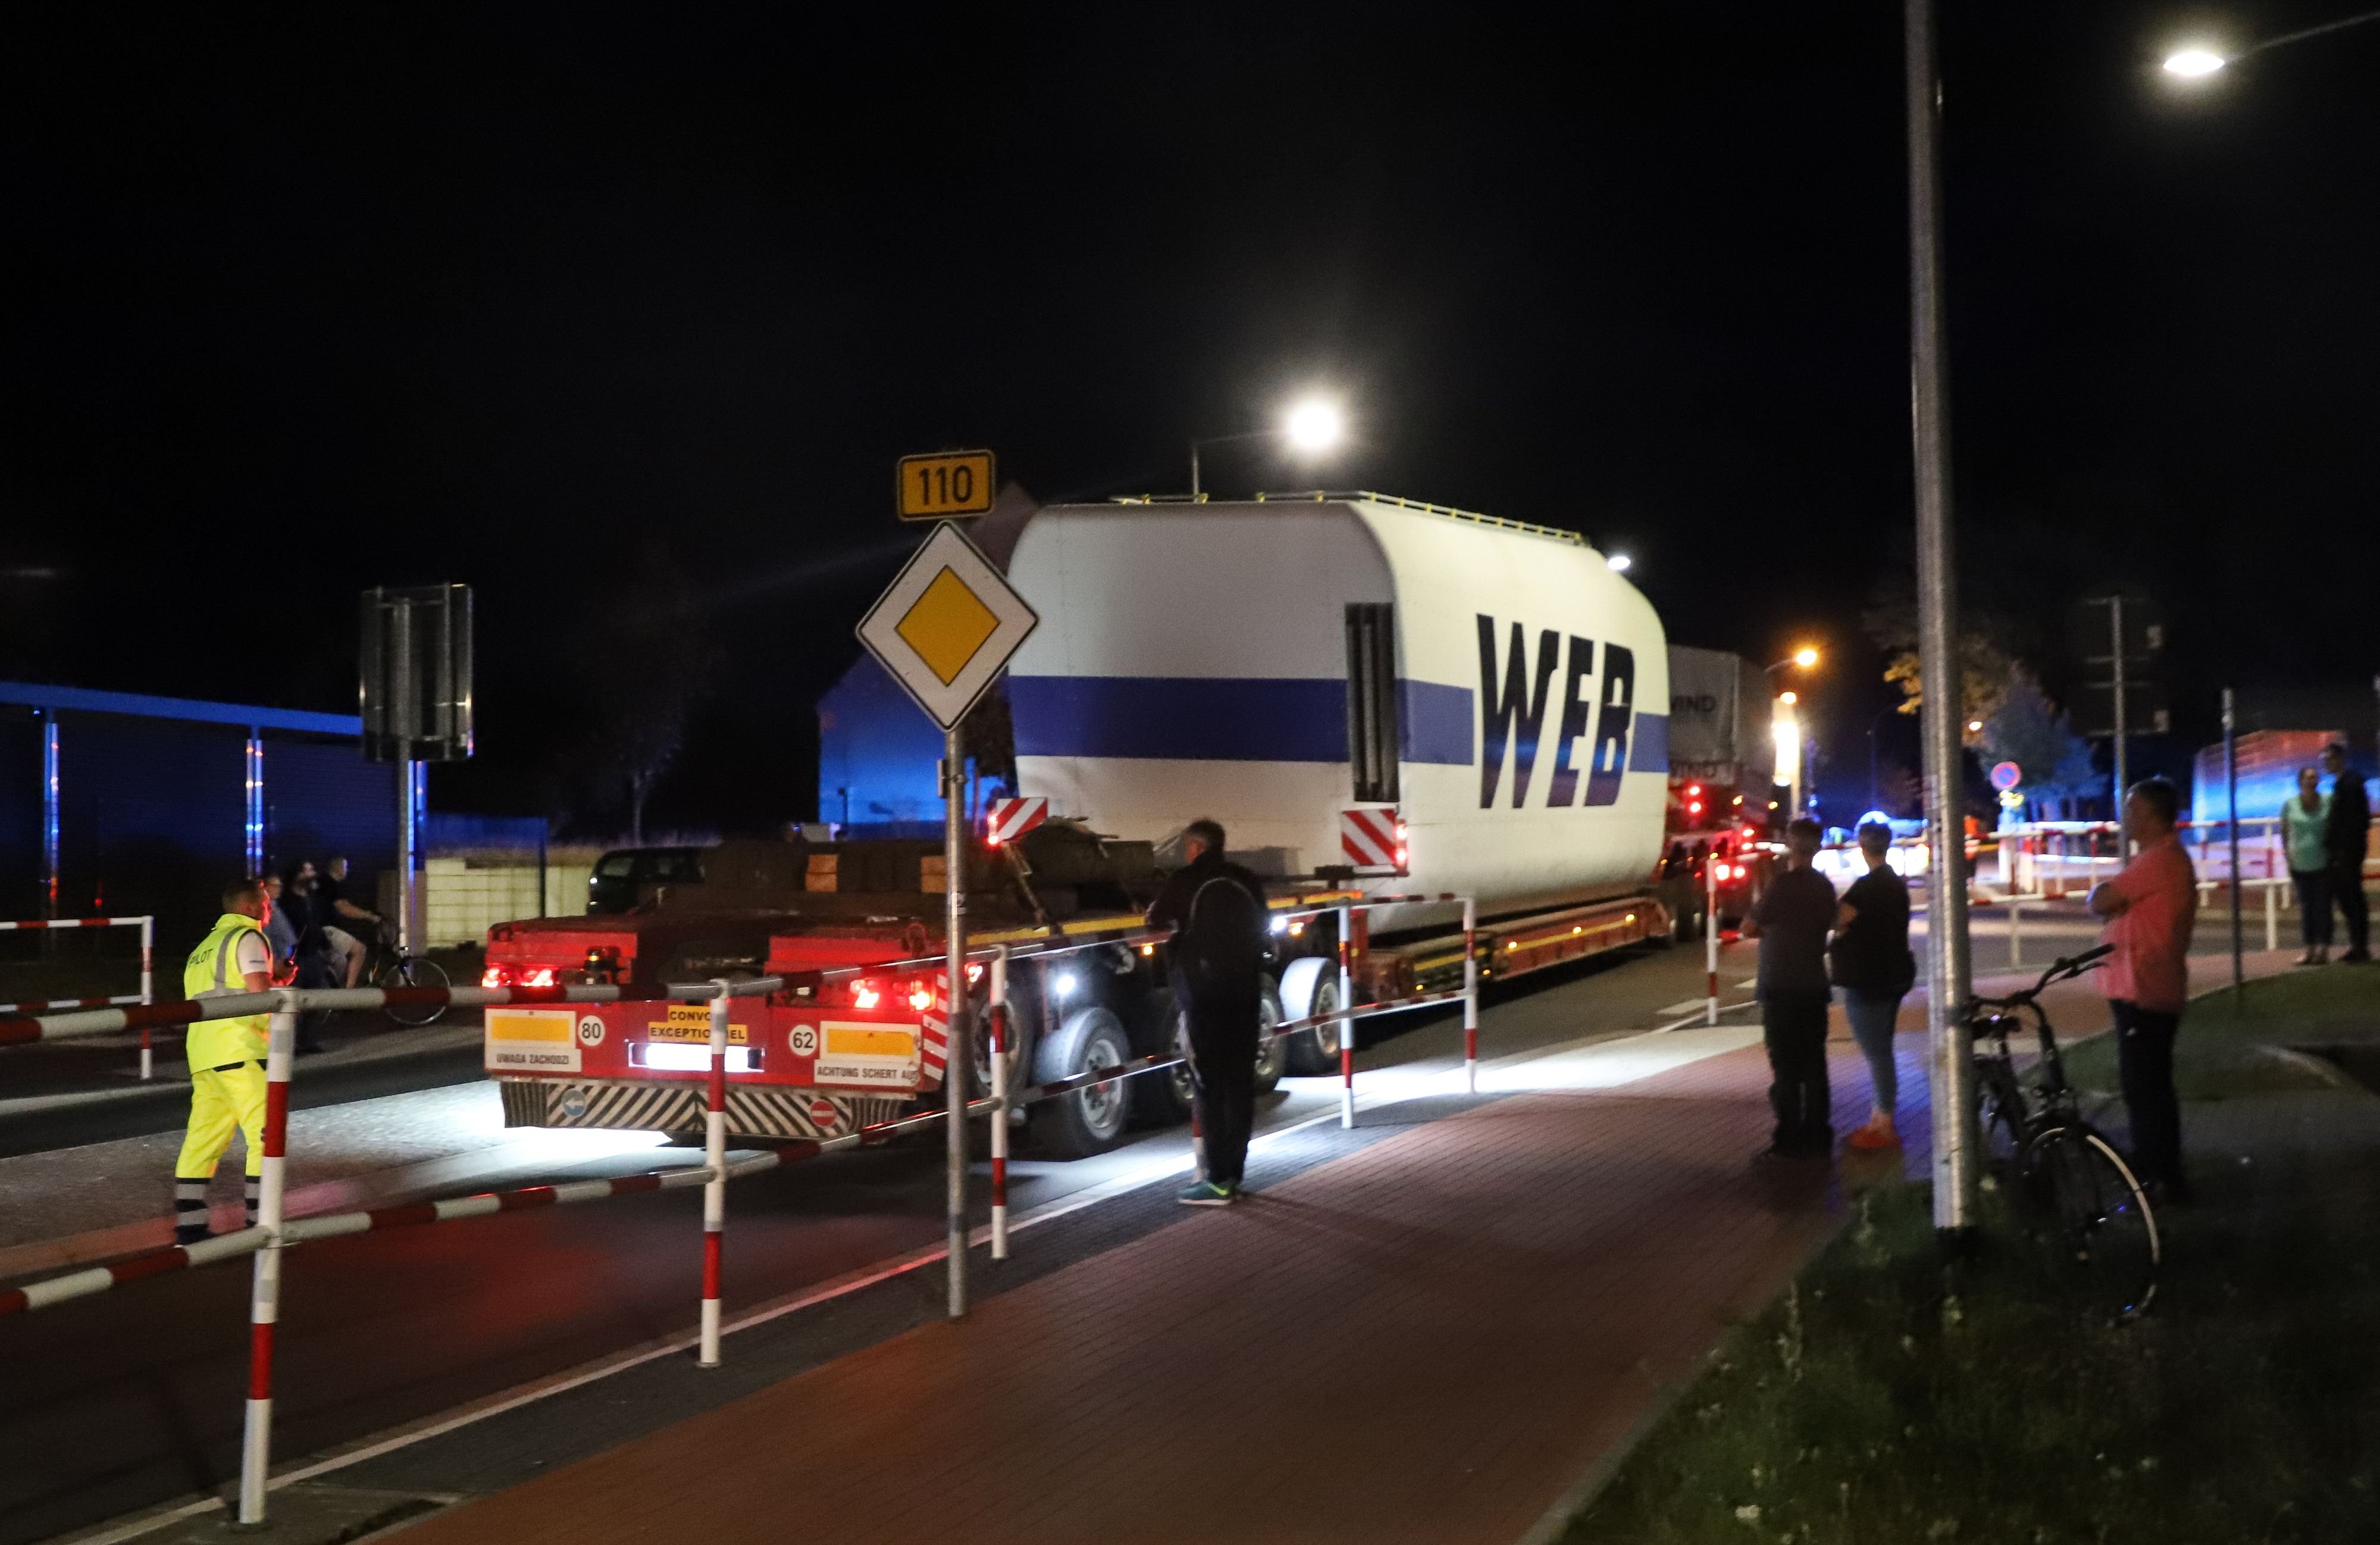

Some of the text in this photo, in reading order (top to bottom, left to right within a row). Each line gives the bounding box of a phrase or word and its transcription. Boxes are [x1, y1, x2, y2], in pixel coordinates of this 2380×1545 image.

[919, 465, 972, 505] 110
[1476, 613, 1635, 809] WEB
[583, 1023, 600, 1039] 80
[651, 1027, 745, 1039] EXCEPTIOEL
[793, 1032, 813, 1048] 62
[817, 1067, 859, 1077] ACHTUNG
[862, 1068, 897, 1078] SCHERT
